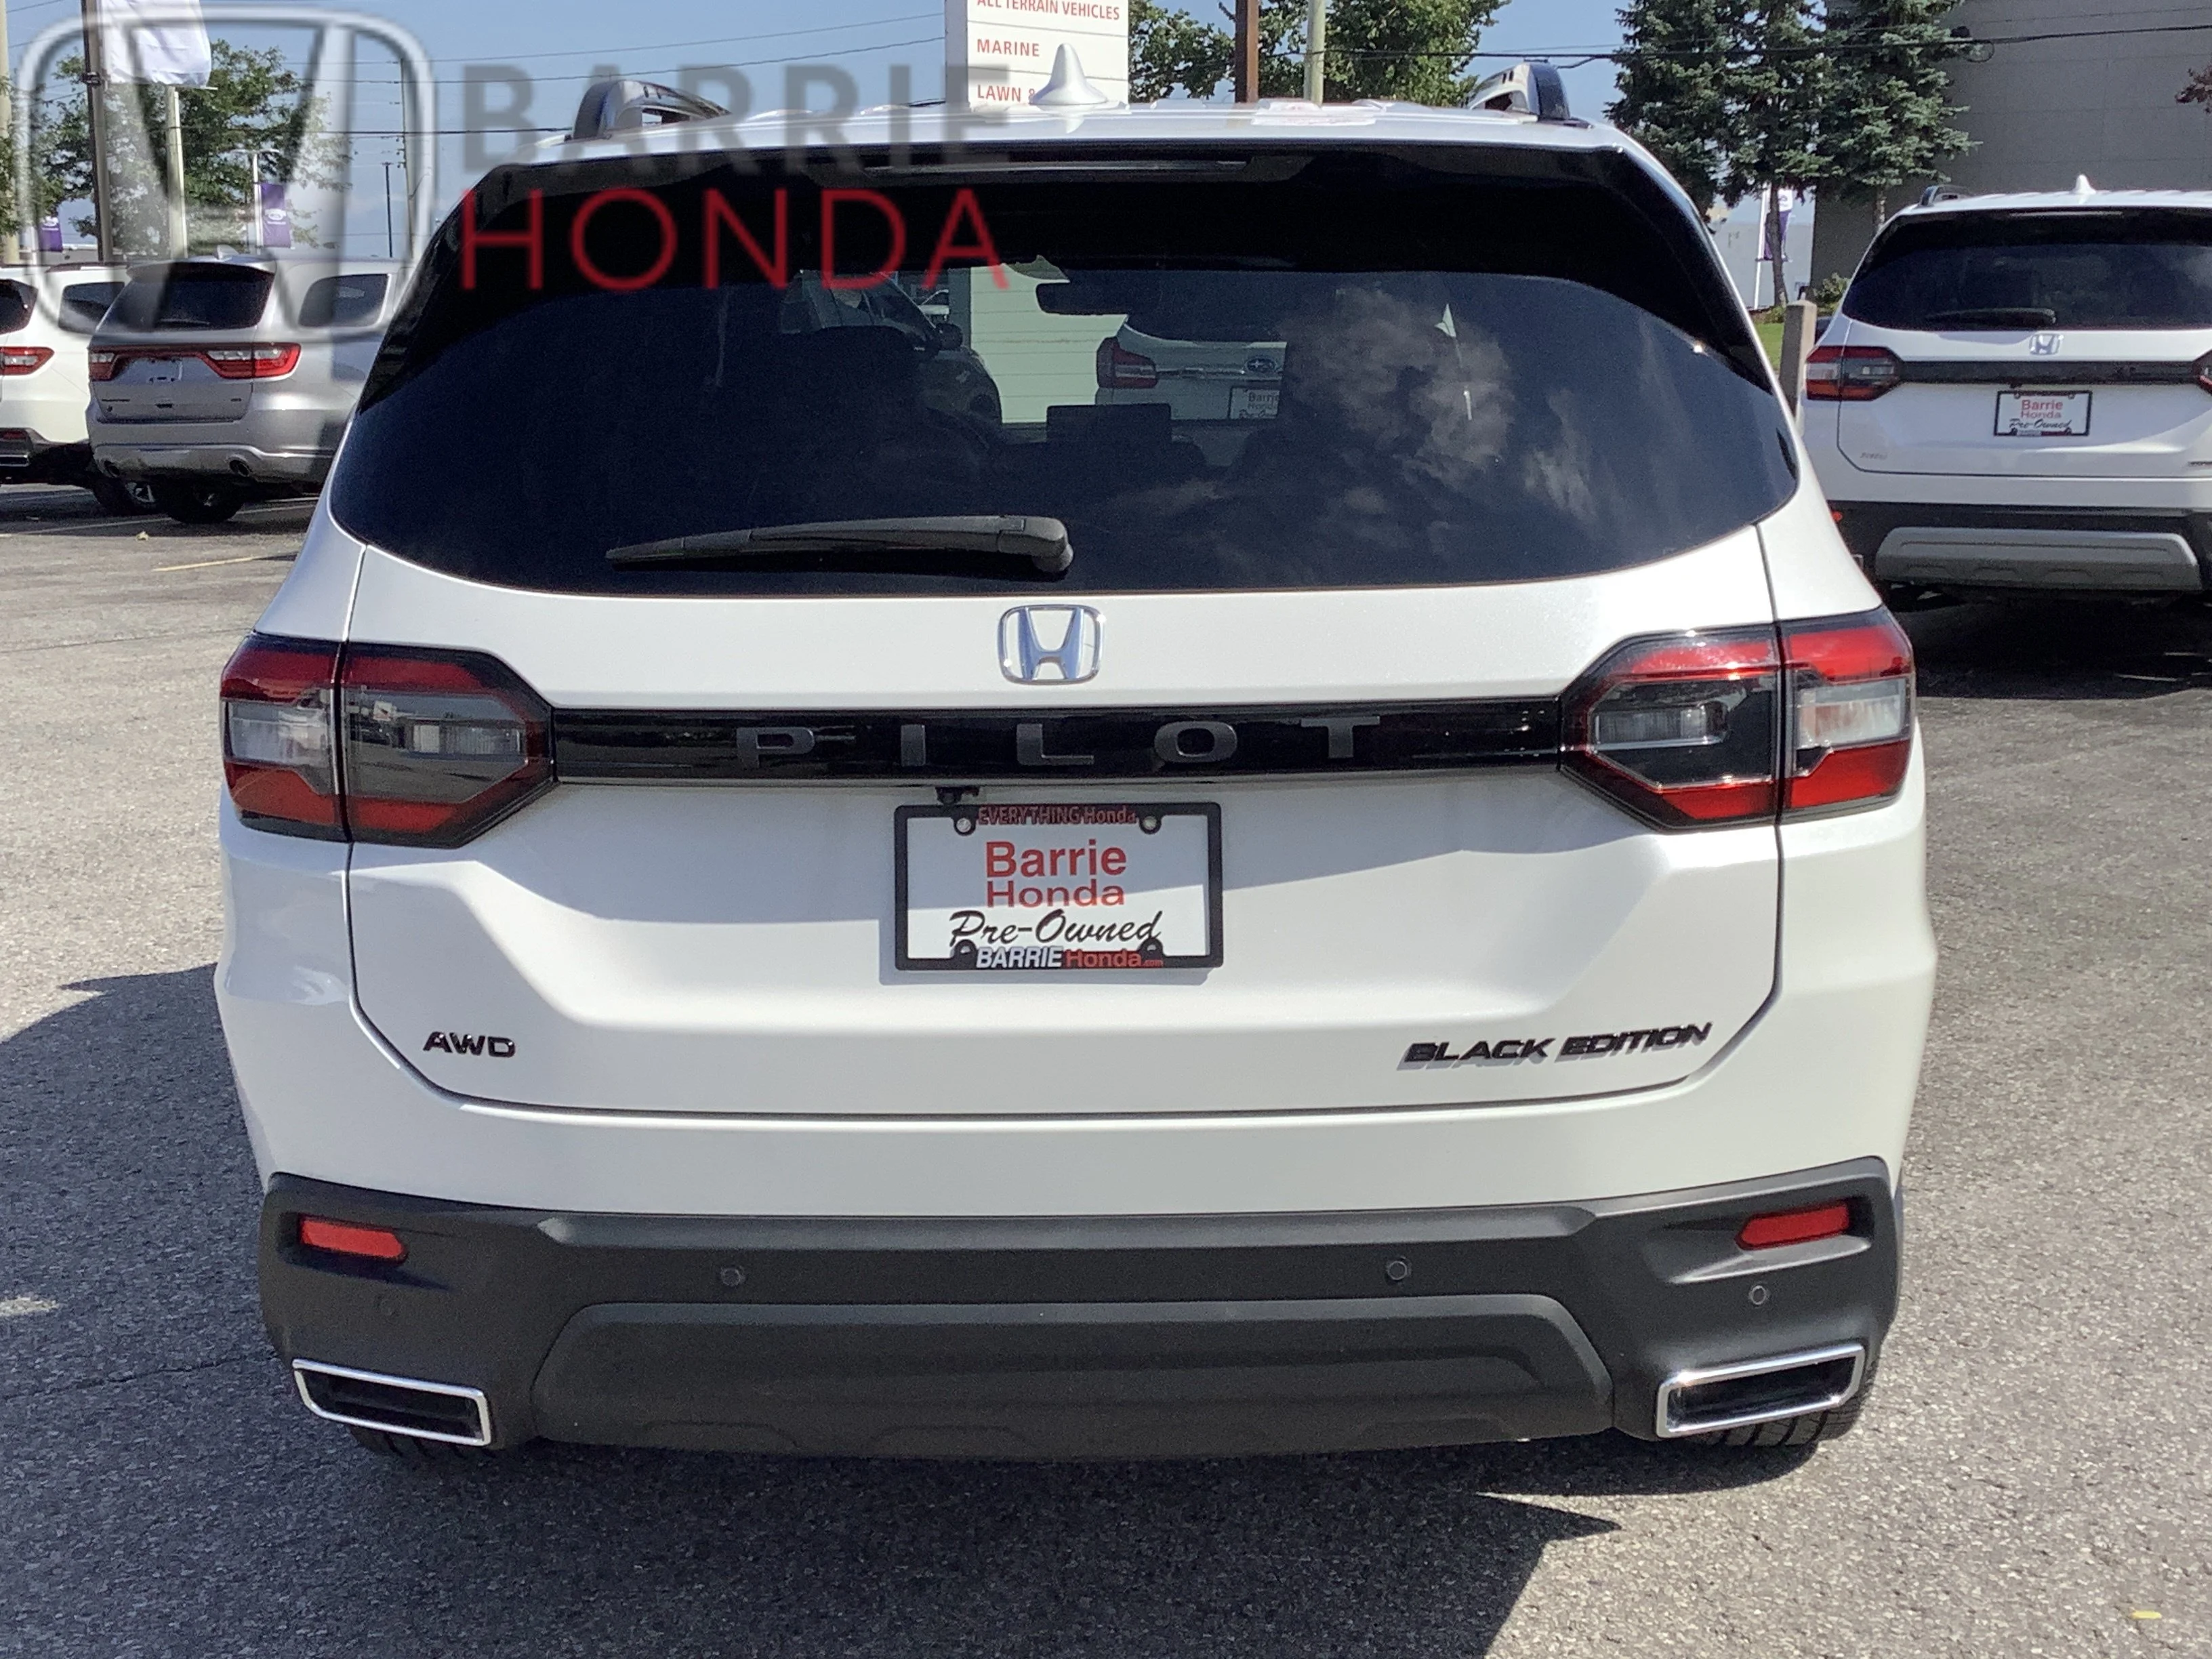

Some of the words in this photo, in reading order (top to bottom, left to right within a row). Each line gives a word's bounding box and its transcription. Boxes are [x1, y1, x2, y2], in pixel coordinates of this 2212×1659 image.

[1005, 0, 1058, 14] TERRAIN
[1062, 1, 1120, 20] VEHICLES
[977, 39, 1040, 57] MARINE
[977, 84, 1021, 102] LAWN
[2021, 411, 2062, 419] Honda
[2022, 400, 2064, 410] Barrie
[737, 716, 1380, 768] PILOT
[977, 806, 1081, 825] EVERYTHING
[1084, 806, 1136, 824] Honda
[986, 840, 1126, 878] Barrie
[987, 878, 1124, 908] Honda
[950, 909, 1162, 947] Pre-Owned
[423, 1031, 516, 1058] AWD
[1403, 1038, 1555, 1063] BLACK
[1559, 1021, 1713, 1057] EDITION
